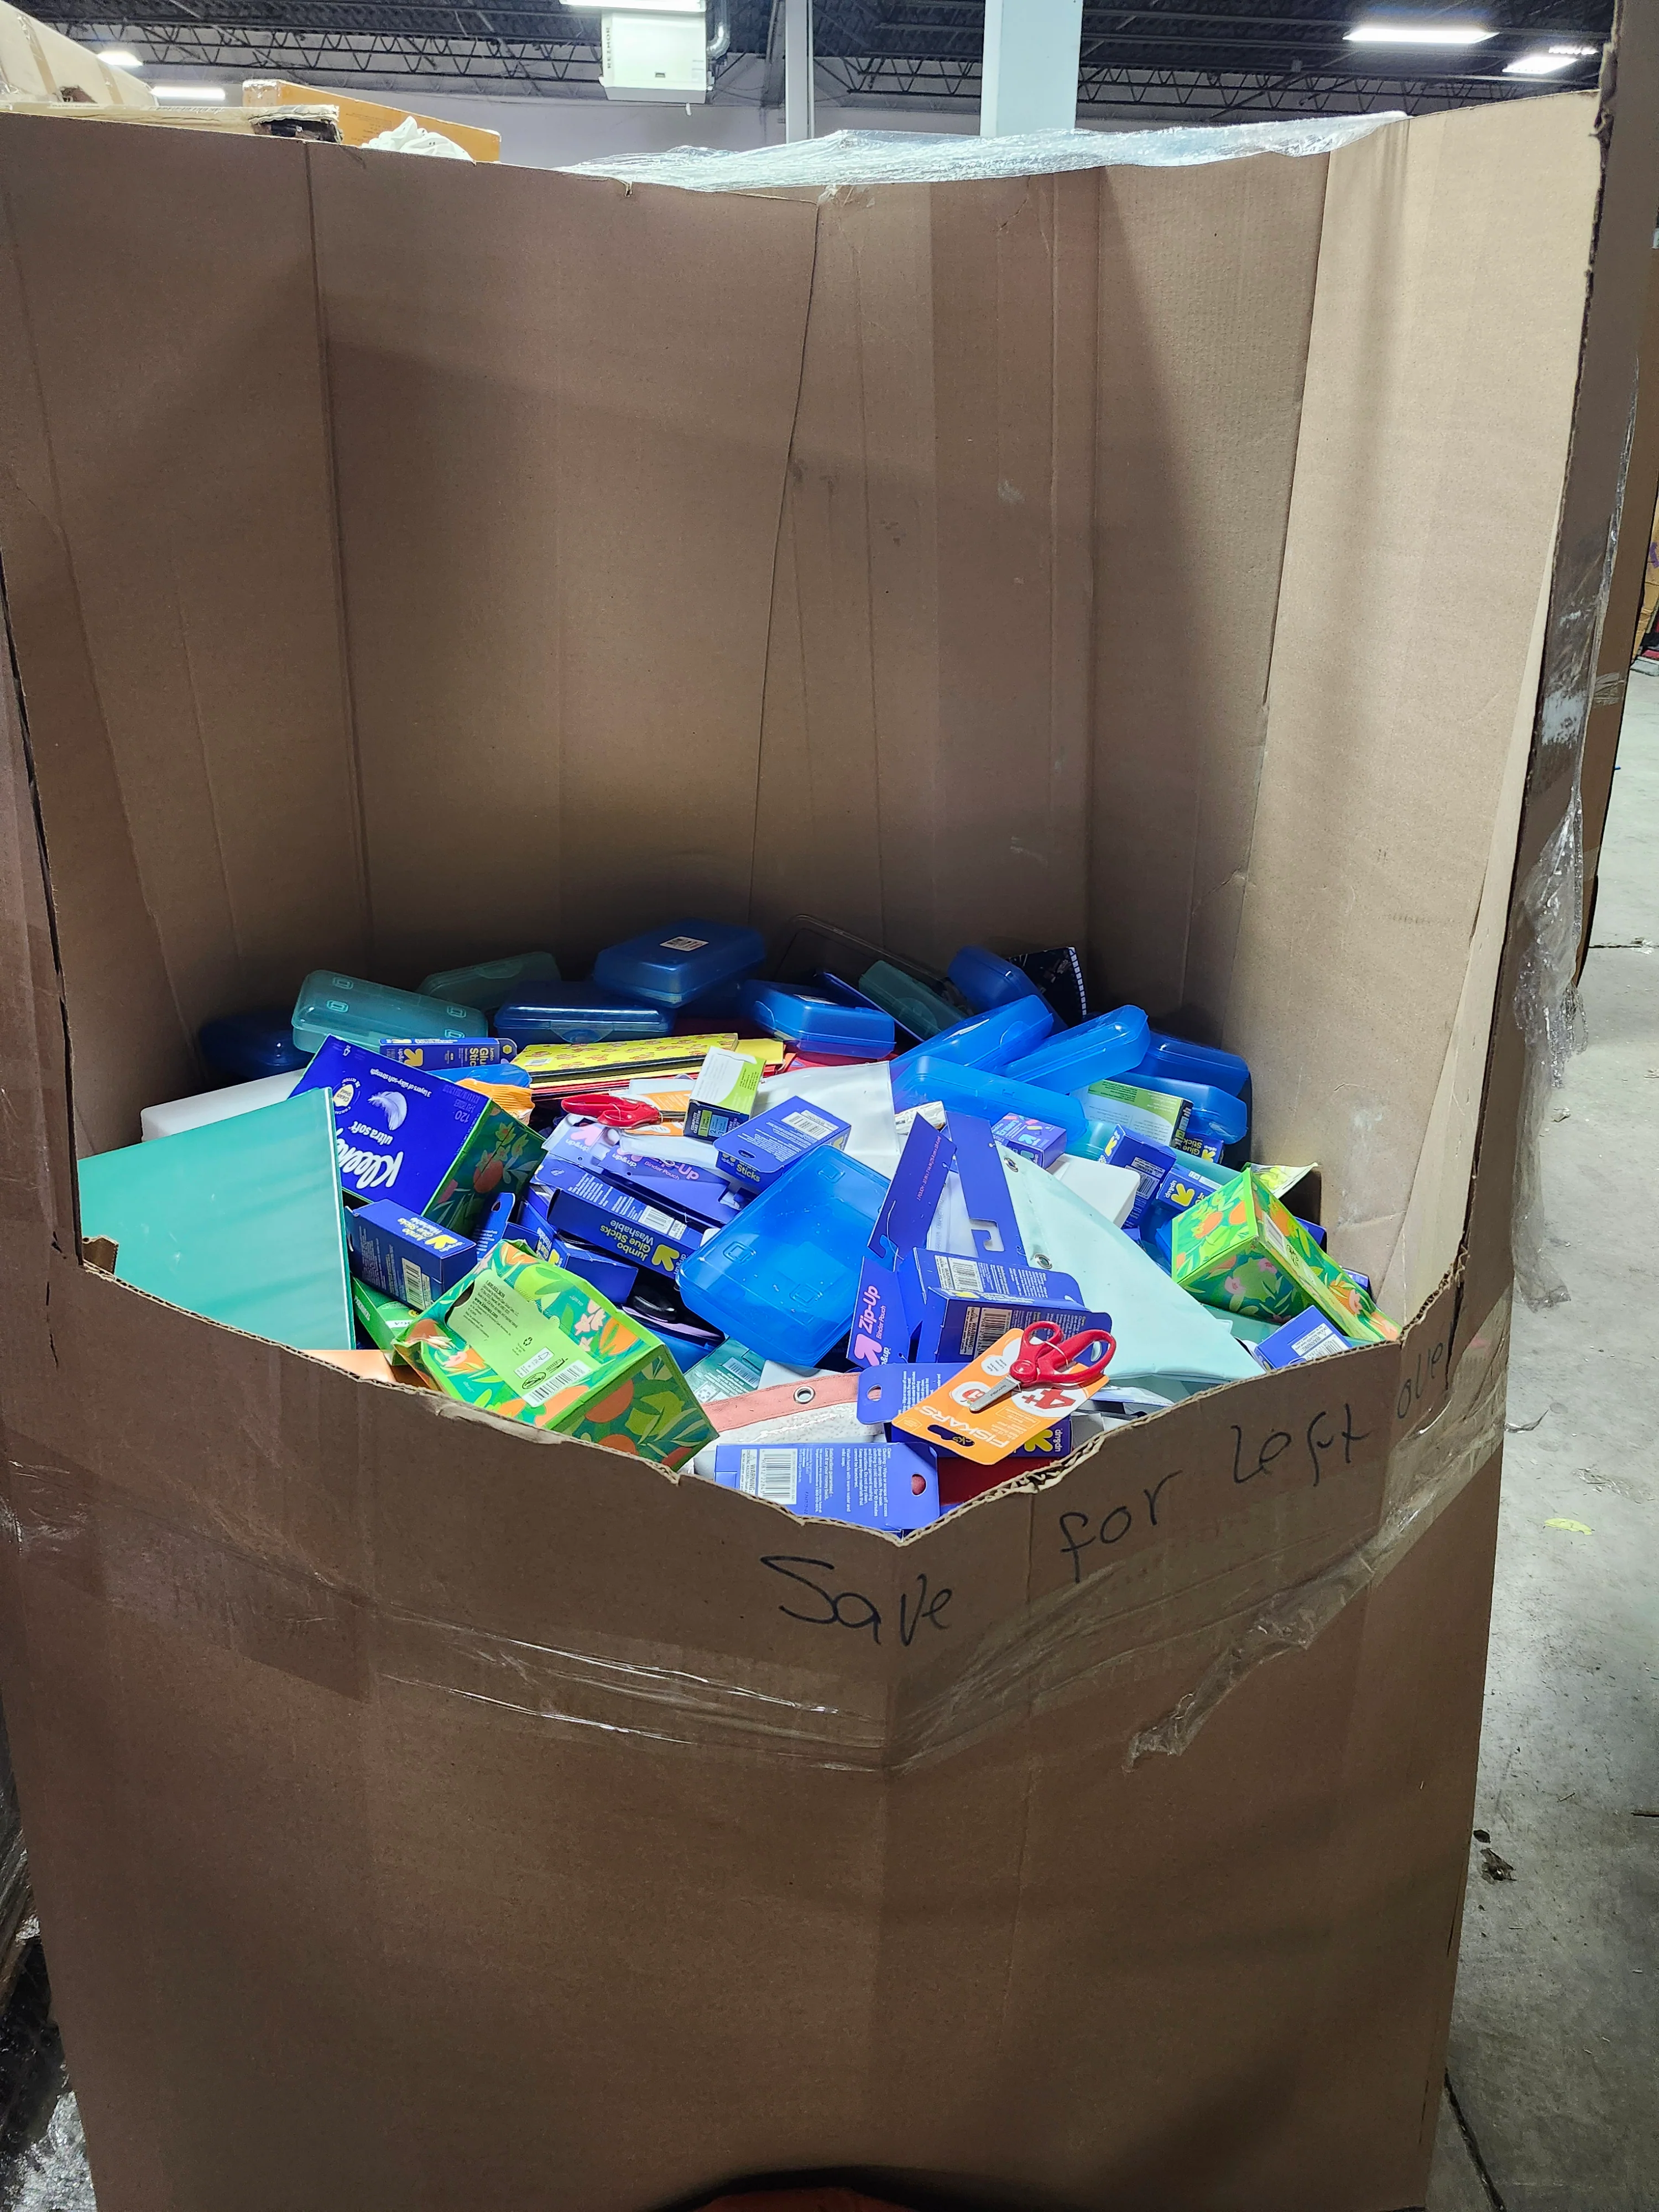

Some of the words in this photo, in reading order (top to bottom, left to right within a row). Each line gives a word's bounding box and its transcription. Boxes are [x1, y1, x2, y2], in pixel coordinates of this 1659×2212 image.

[469, 1047, 478, 1067] Stic
[479, 1047, 488, 1065] Glu
[370, 1068, 388, 1080] strength
[406, 1082, 414, 1091] of
[413, 1083, 429, 1096] layers
[336, 1092, 349, 1103] Clean
[453, 1108, 471, 1124] 120
[352, 1121, 370, 1135] soft
[369, 1129, 394, 1145] ultra
[564, 1137, 590, 1153] up&up
[1182, 1145, 1200, 1155] Glue
[336, 1128, 402, 1188] Kleene
[611, 1152, 637, 1168] up&up
[644, 1160, 663, 1173] Binder
[661, 1168, 680, 1181] Pouch
[735, 1164, 761, 1182] Sticks
[1164, 1178, 1178, 1199] up&up
[598, 1224, 629, 1243] Sticks
[608, 1219, 655, 1245] Washable
[615, 1241, 648, 1261] Jumbo
[627, 1237, 651, 1253] Glue
[858, 1285, 880, 1334] Zip-Up
[968, 1322, 977, 1349] WARNING:
[881, 1347, 891, 1365] p&up
[919, 1405, 1010, 1448] FISKARS
[1054, 1428, 1064, 1453] up&up
[760, 1555, 953, 1647] Save
[1060, 1469, 1184, 1584] for
